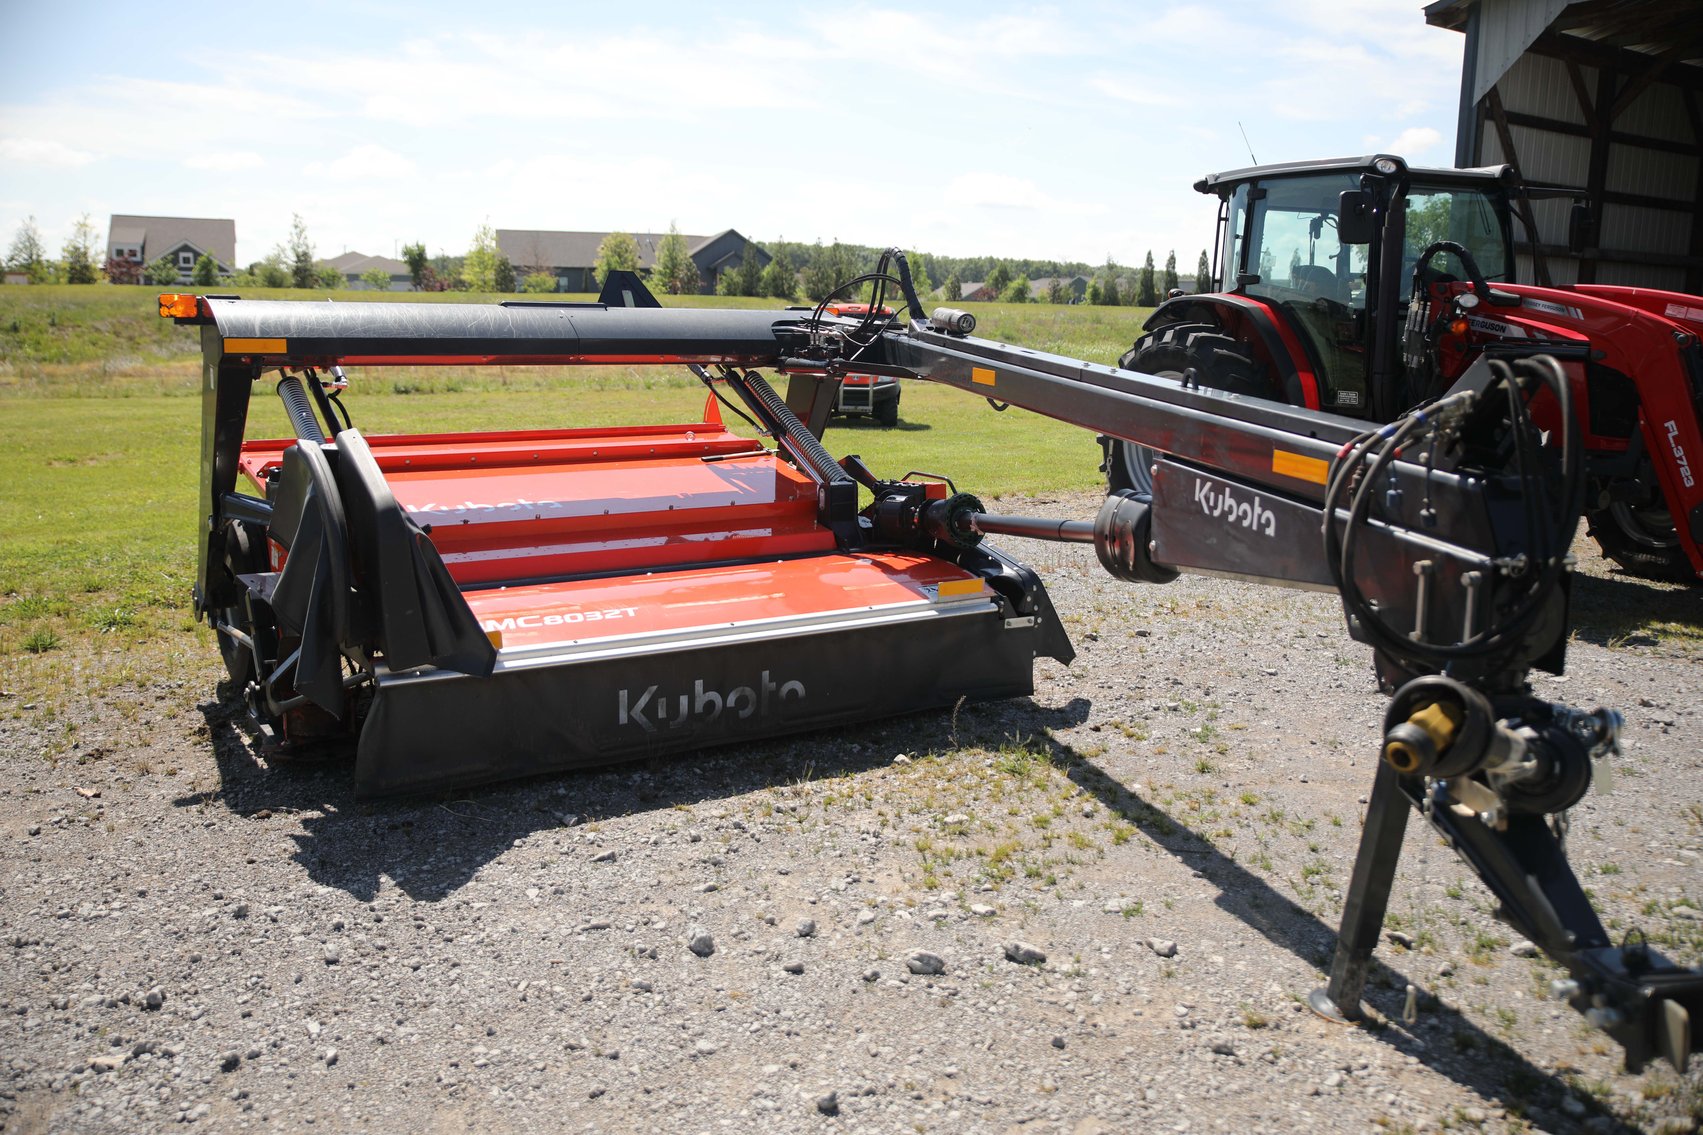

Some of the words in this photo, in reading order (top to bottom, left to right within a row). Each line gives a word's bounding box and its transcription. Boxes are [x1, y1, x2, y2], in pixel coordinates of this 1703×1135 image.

[406, 498, 562, 515] Kubota
[1194, 478, 1276, 537] Kubota
[479, 607, 639, 632] MC8032T
[618, 669, 806, 732] Kubota
